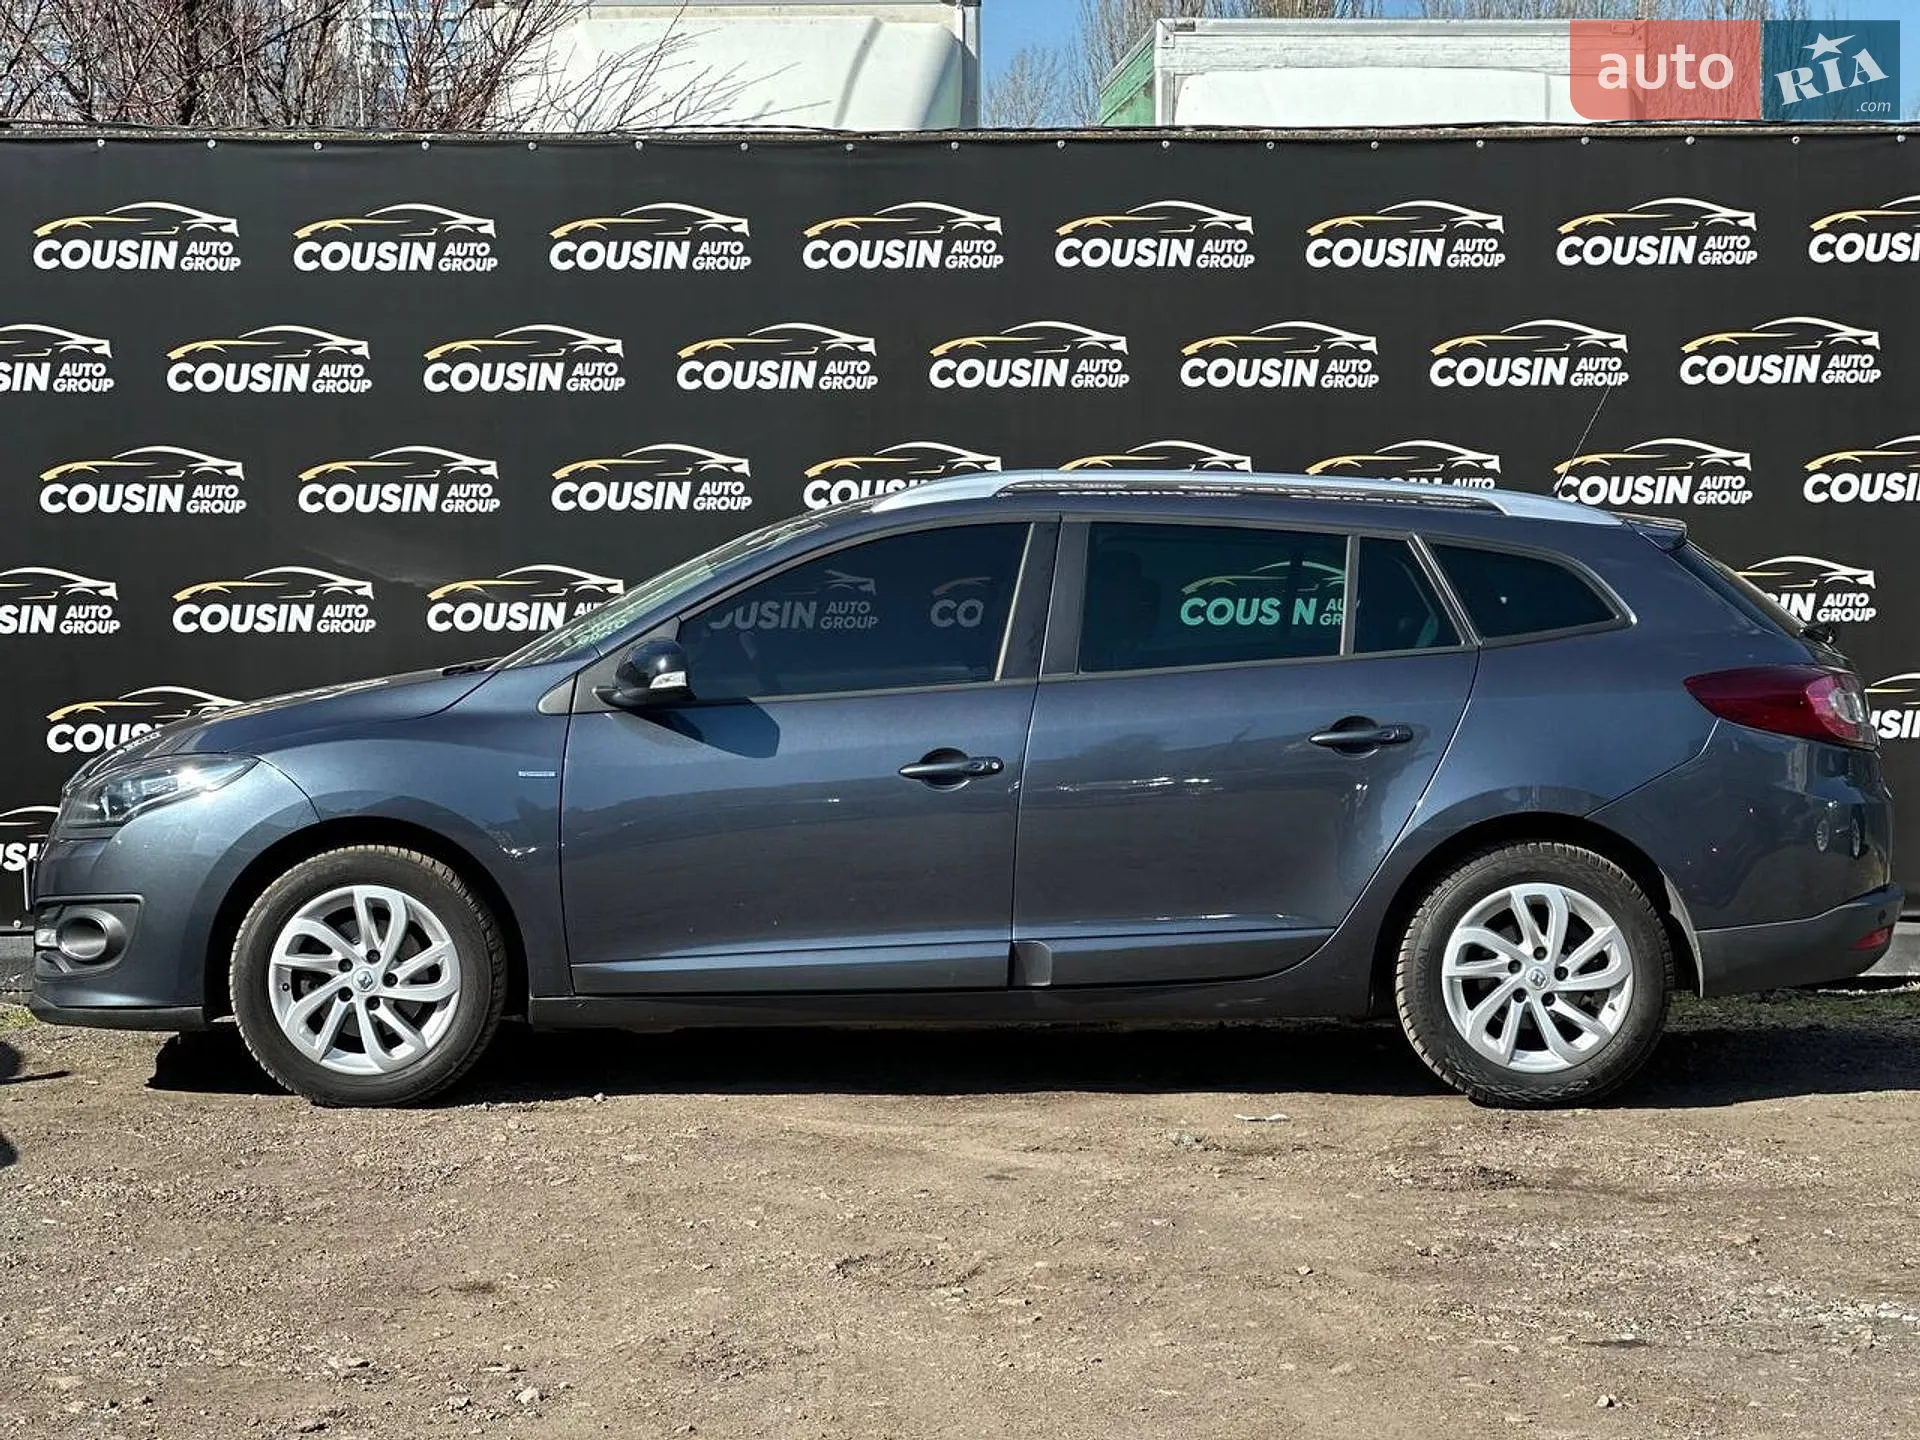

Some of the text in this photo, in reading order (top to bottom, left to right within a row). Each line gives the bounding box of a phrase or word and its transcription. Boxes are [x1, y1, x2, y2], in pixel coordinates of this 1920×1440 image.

[186, 241, 233, 256] AUTO
[444, 242, 490, 256] AUTO
[698, 241, 744, 255] AUTO
[951, 240, 997, 254] AUTO
[1202, 239, 1247, 253] AUTO
[1453, 238, 1498, 252] AUTO
[1704, 235, 1750, 250] AUTO
[33, 239, 178, 269] COUSIN
[294, 242, 436, 271] COUSIN
[550, 240, 690, 270] COUSIN
[803, 239, 943, 269] COUSIN
[1055, 238, 1194, 267] COUSIN
[1306, 238, 1445, 268] COUSIN
[1556, 236, 1697, 266] COUSIN
[1698, 250, 1757, 265] GROUP
[180, 257, 241, 271] GROUP
[438, 257, 498, 271] GROUP
[692, 256, 751, 270] GROUP
[945, 255, 1004, 269] GROUP
[1196, 254, 1255, 268] GROUP
[1446, 253, 1505, 268] GROUP
[824, 360, 870, 374] AUTO
[1077, 359, 1122, 373] AUTO
[1326, 359, 1372, 373] AUTO
[1576, 357, 1622, 371] AUTO
[1827, 354, 1874, 368] AUTO
[59, 363, 107, 377] AUTO
[317, 364, 364, 378] AUTO
[572, 362, 618, 376] AUTO
[677, 360, 817, 390] COUSIN
[929, 358, 1069, 388] COUSIN
[1181, 358, 1319, 387] COUSIN
[1430, 357, 1569, 387] COUSIN
[1680, 355, 1820, 385] COUSIN
[1821, 369, 1881, 383] GROUP
[167, 362, 310, 392] COUSIN
[424, 362, 564, 392] COUSIN
[566, 377, 625, 391] GROUP
[819, 375, 878, 390] GROUP
[1071, 374, 1130, 388] GROUP
[1321, 374, 1379, 388] GROUP
[1570, 372, 1629, 386] GROUP
[53, 378, 115, 392] GROUP
[312, 379, 372, 393] GROUP
[699, 481, 745, 495] AUTO
[1699, 476, 1745, 489] AUTO
[1803, 473, 1920, 503] COUSI
[192, 485, 239, 499] AUTO
[447, 483, 493, 497] AUTO
[551, 481, 691, 511] COUSIN
[803, 479, 929, 510] COU
[1553, 475, 1692, 505] COUSIN
[40, 483, 184, 513] COUSIN
[299, 483, 439, 513] COUSIN
[693, 496, 752, 510] GROUP
[1693, 491, 1753, 504] GROUP
[186, 500, 247, 513] GROUP
[441, 498, 500, 512] GROUP
[825, 600, 871, 614] AUTO
[1823, 593, 1870, 607] AUTO
[65, 605, 113, 619] AUTO
[322, 604, 368, 618] AUTO
[426, 601, 566, 632] COUSIN
[1816, 608, 1877, 622] GROUP
[173, 604, 315, 633] COUSIN
[820, 615, 879, 630] GROUP
[59, 620, 121, 634] GROUP
[317, 619, 376, 633] GROUP
